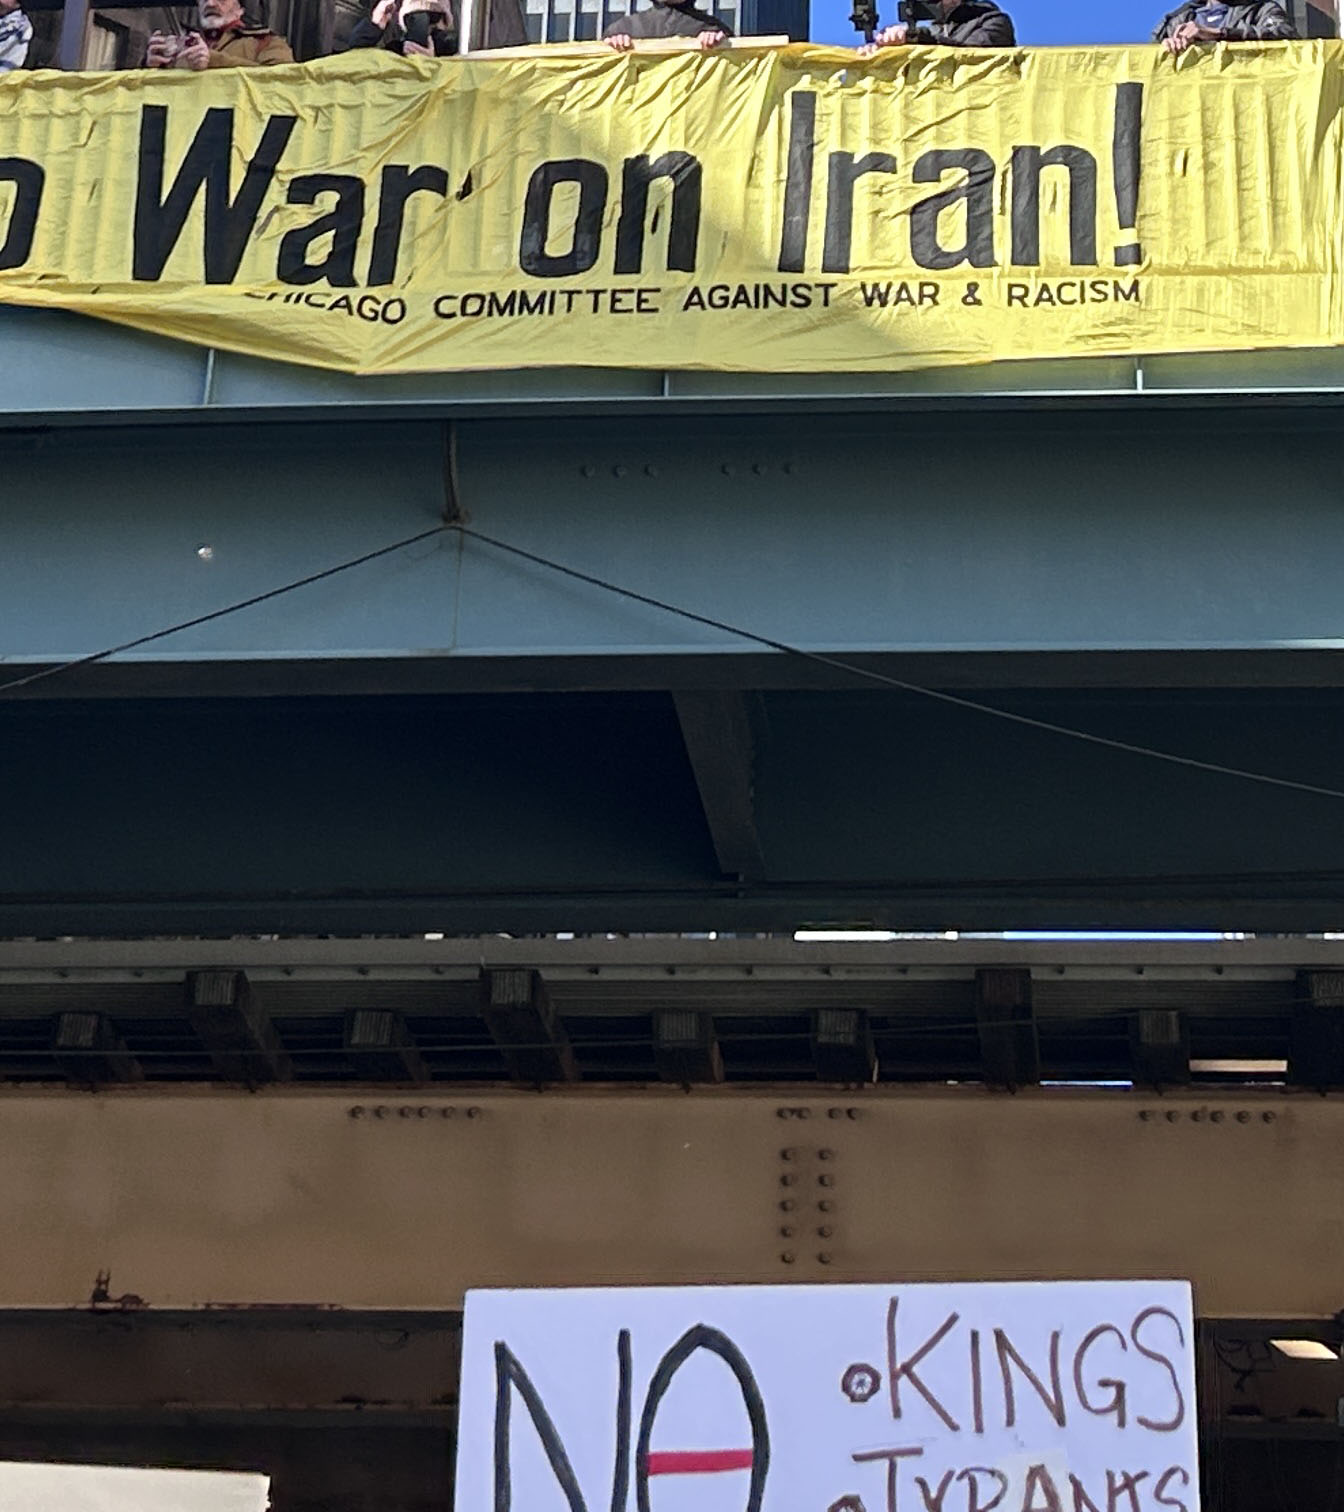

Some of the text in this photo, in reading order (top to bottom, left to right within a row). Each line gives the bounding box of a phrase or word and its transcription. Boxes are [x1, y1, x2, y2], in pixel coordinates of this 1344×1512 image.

[132, 104, 450, 288] War
[518, 151, 702, 278] on
[777, 82, 1144, 274] Iran!
[433, 288, 662, 319] COMMITTEE
[682, 283, 839, 312] AGAINST
[860, 280, 941, 309] WAR
[960, 281, 983, 307] &
[1007, 280, 1142, 309] RACISM
[886, 1295, 1188, 1434] KINGS
